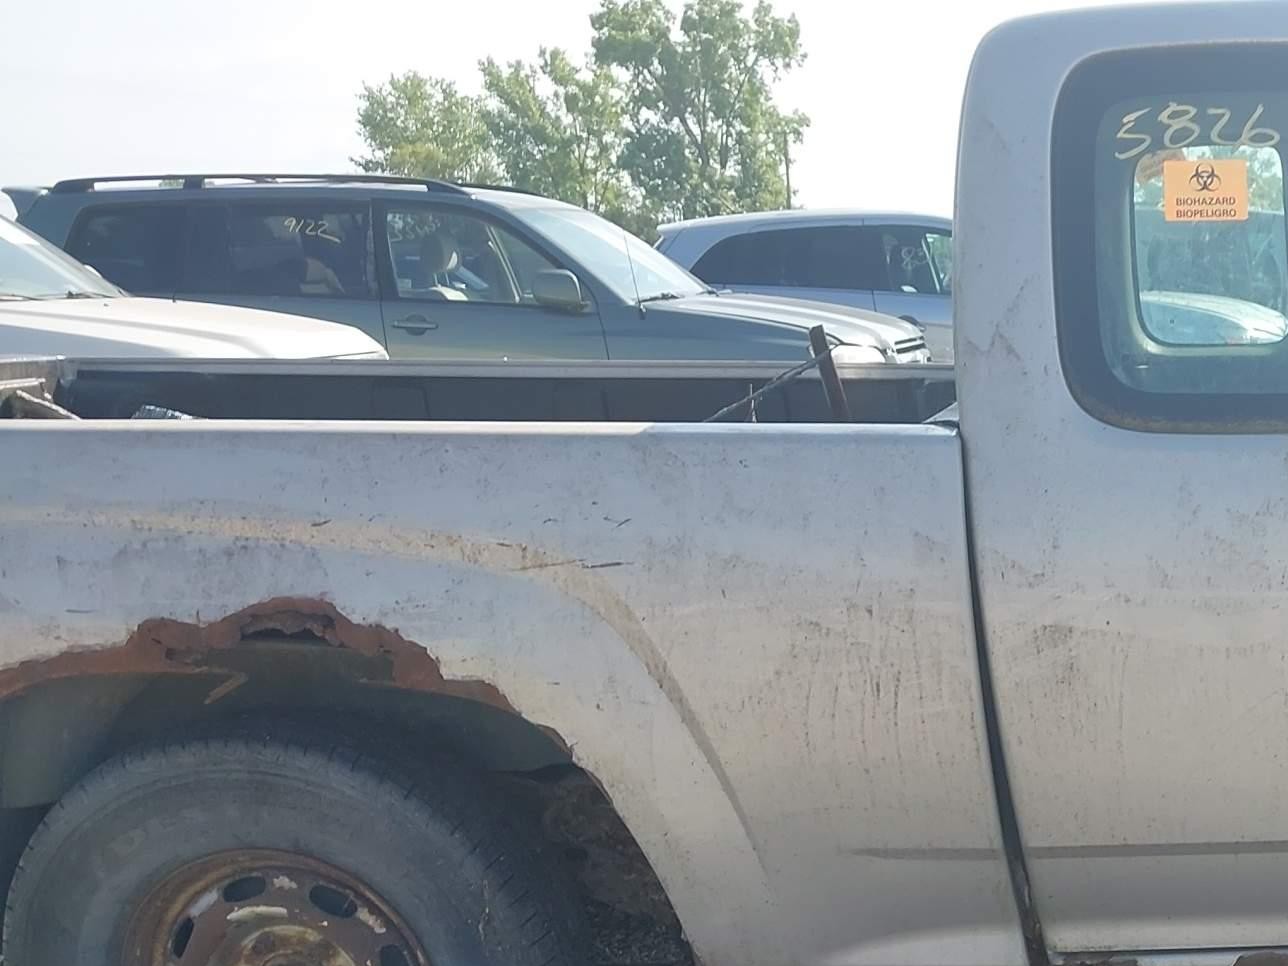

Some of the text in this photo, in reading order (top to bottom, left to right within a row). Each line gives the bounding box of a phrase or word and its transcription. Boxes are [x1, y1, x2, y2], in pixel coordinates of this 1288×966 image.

[1115, 102, 1281, 160] 5826
[1175, 196, 1237, 207] BIOHAZARD
[1175, 208, 1237, 219] BIOPELIGRO
